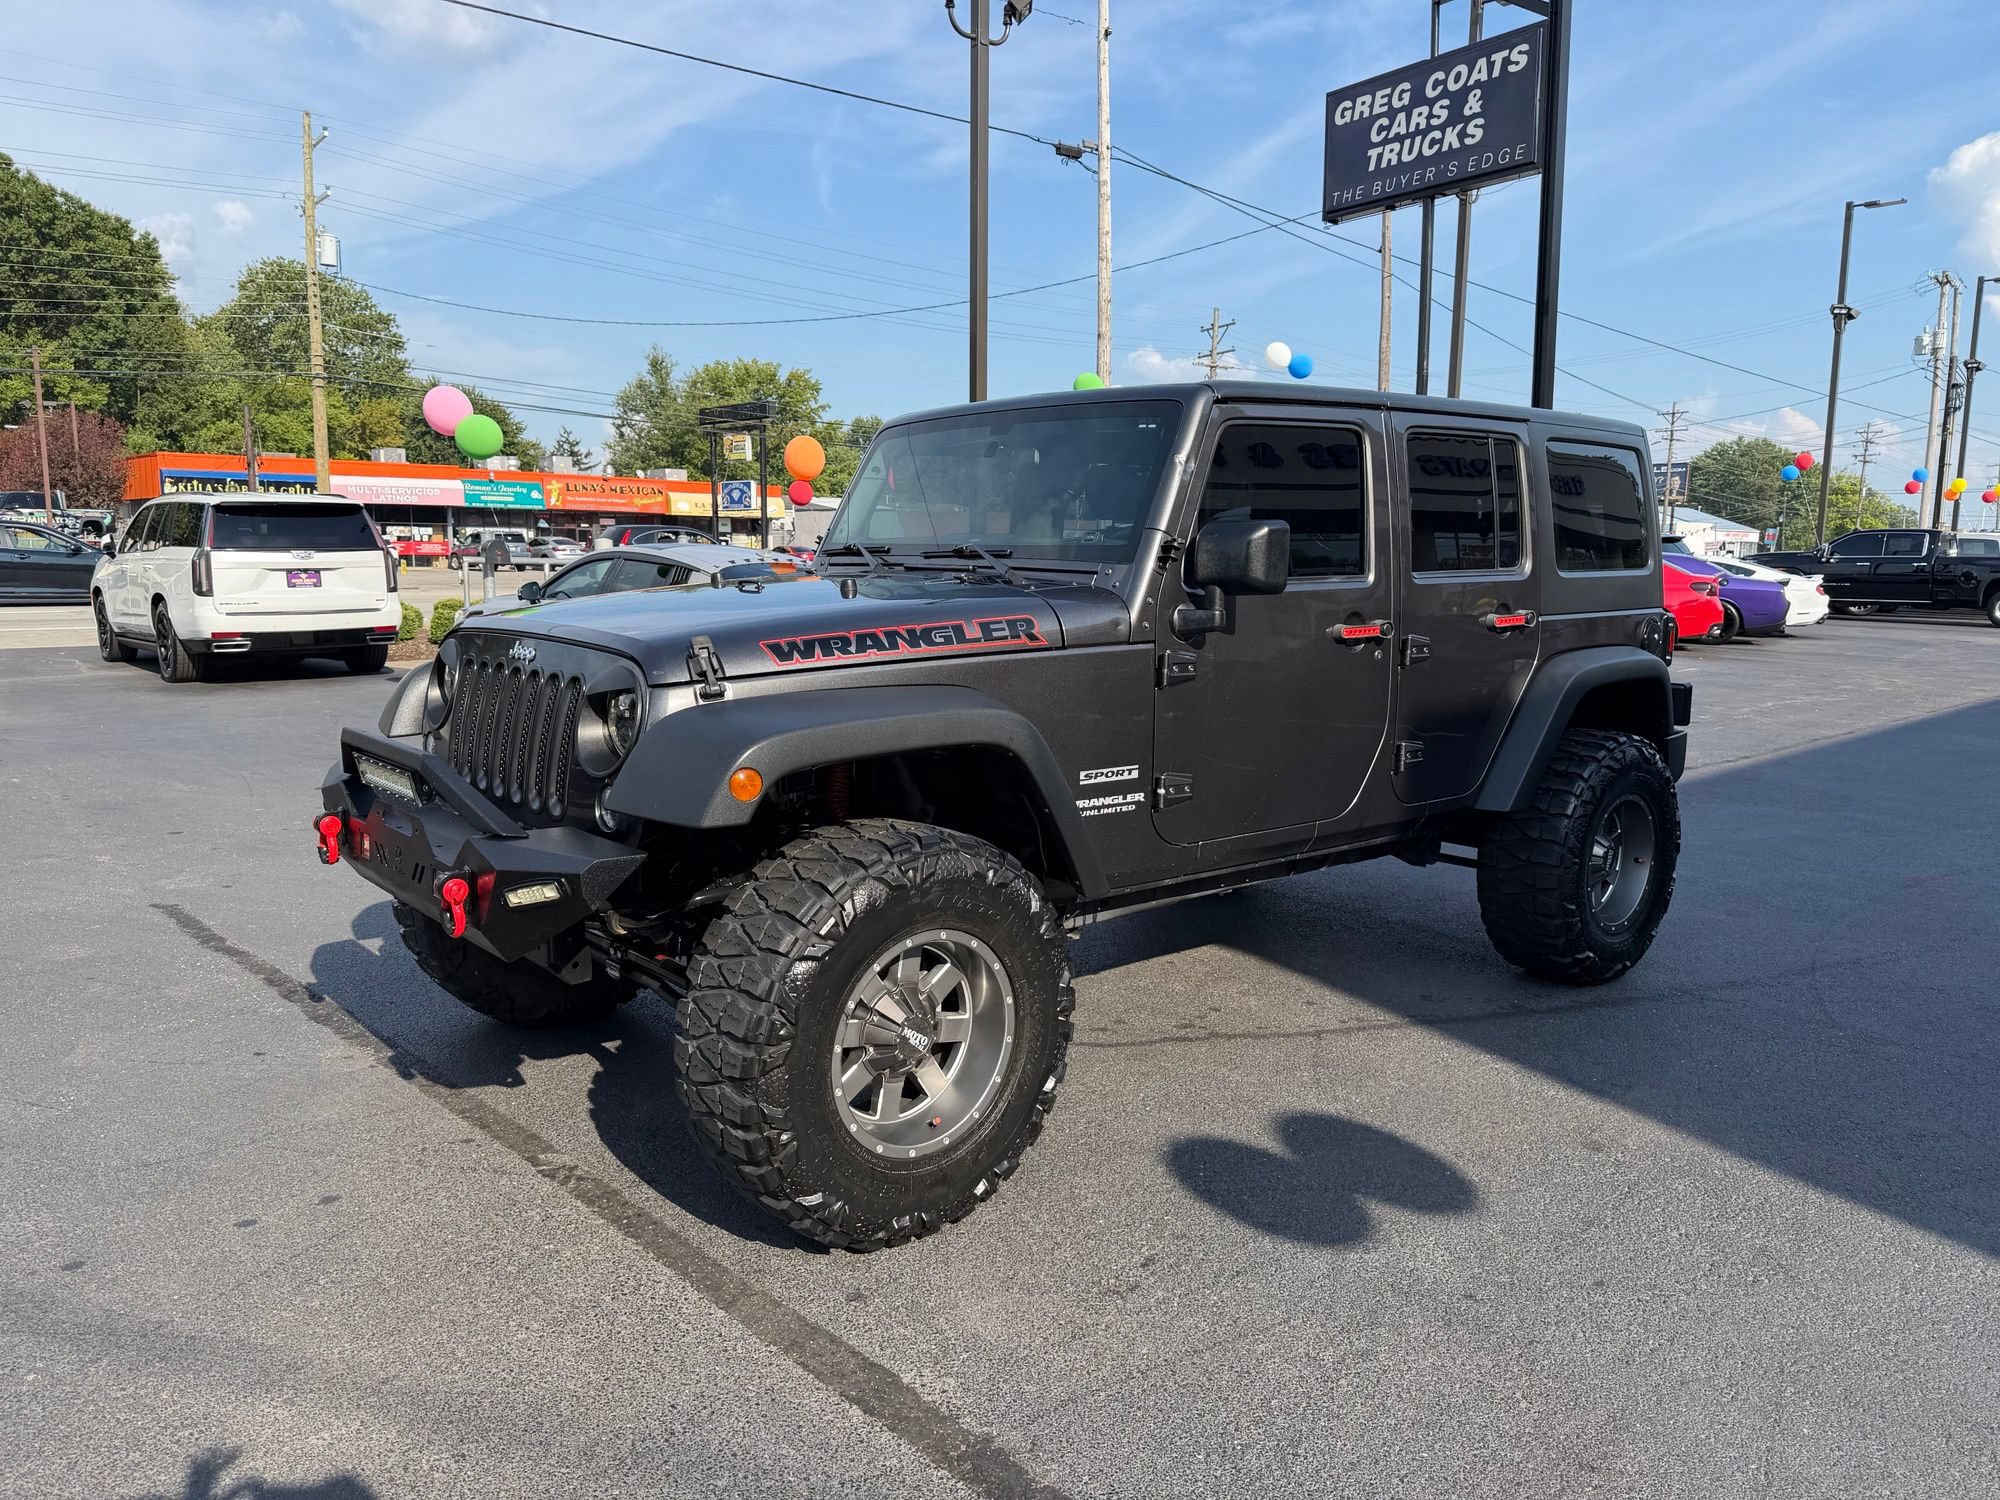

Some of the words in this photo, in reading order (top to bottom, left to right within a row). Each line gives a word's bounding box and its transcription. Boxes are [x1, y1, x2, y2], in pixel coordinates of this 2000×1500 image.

[1334, 81, 1412, 126] GREG
[1425, 43, 1530, 99] COATS
[1370, 98, 1451, 143] CARS
[1463, 88, 1483, 116] &
[1366, 117, 1485, 172] TRUCKS
[1332, 185, 1365, 206] THE
[1372, 160, 1459, 196] BUYER'S
[1467, 143, 1527, 173] EDGE
[241, 484, 265, 493] BR
[347, 485, 441, 496] MULTI-SERVICIOS
[371, 494, 418, 503] LATINOS
[565, 482, 606, 494] LUNA'S
[609, 486, 665, 497] MEXICAN
[761, 616, 1046, 665] WRANGLER
[509, 640, 536, 665] Jeep
[1083, 768, 1134, 781] SPORT
[900, 1026, 929, 1046] MOTO
